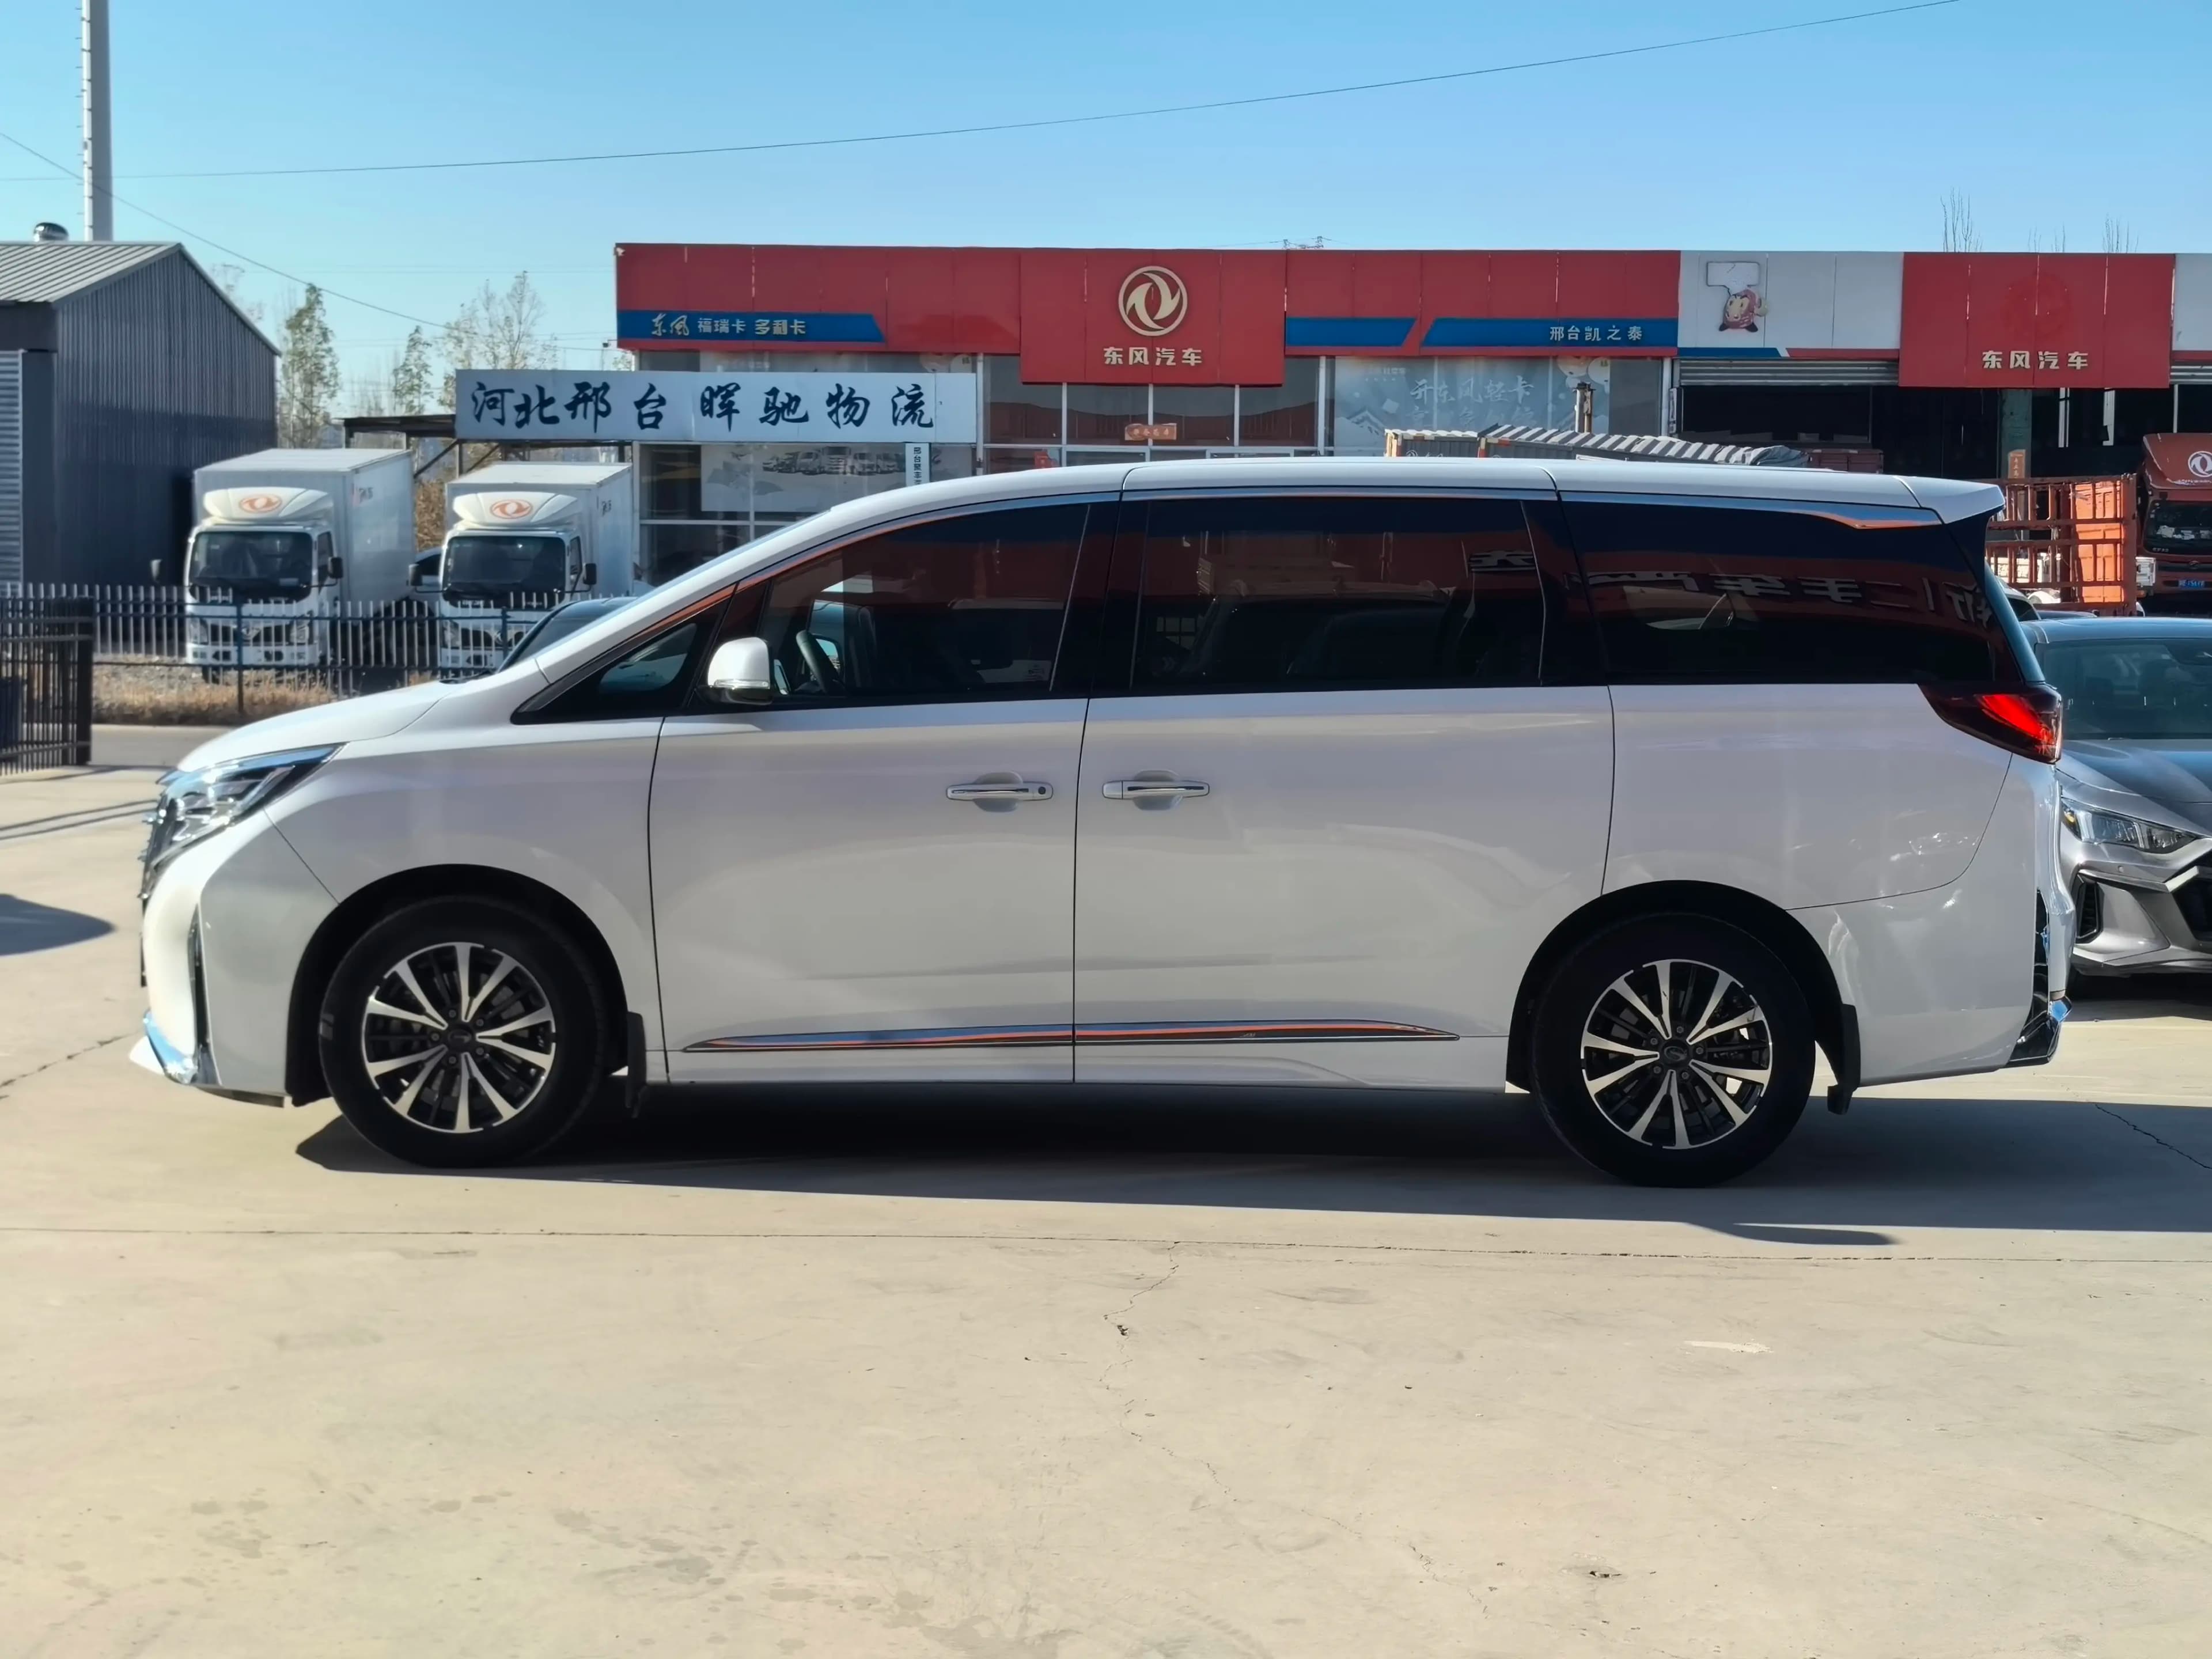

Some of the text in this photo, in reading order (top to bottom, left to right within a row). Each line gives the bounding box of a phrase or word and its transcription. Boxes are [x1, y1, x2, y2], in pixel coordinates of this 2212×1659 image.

[652, 313, 806, 336] 东风 福瑞卡 多利卡
[1550, 325, 1642, 342] 邢台凯之泰
[1103, 347, 1202, 366] 东风汽车
[1982, 350, 2089, 370] 东风汽车
[471, 381, 934, 433] 河北邢台晖驰物流
